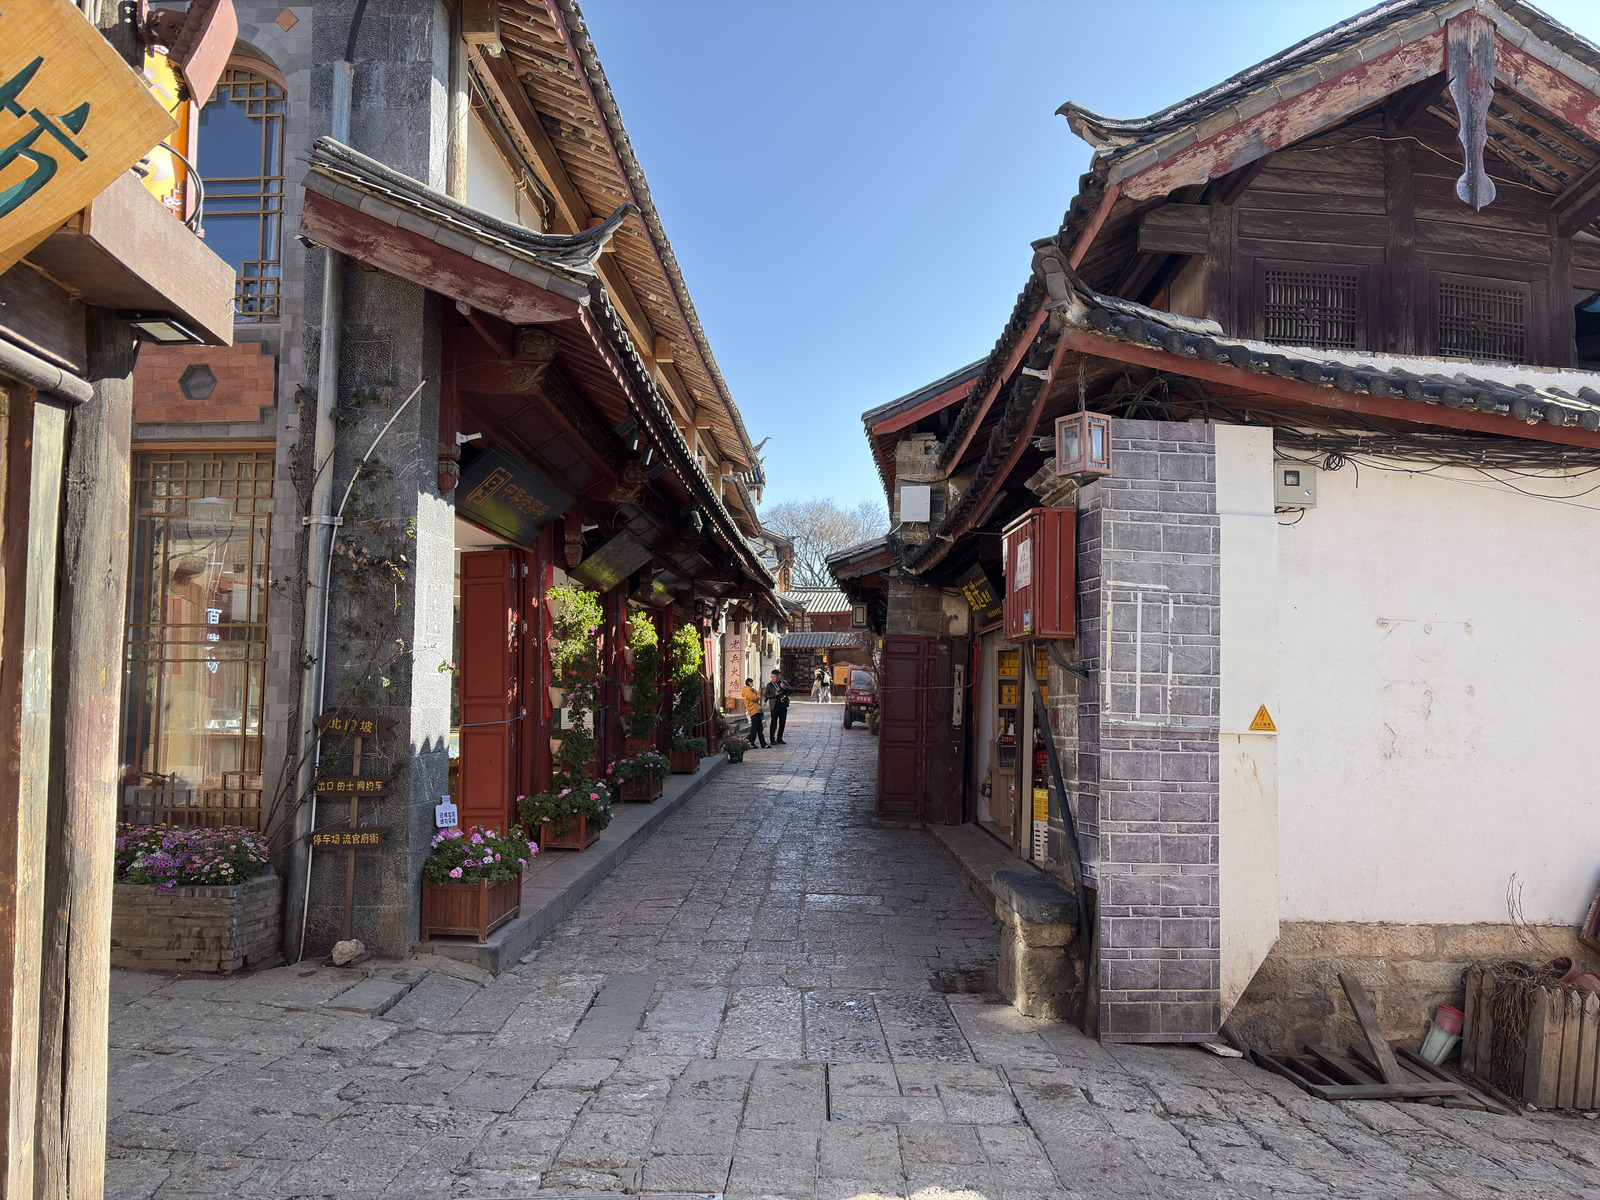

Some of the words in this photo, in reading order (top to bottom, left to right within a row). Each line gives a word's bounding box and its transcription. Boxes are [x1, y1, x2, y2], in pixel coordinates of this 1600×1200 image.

[729, 639, 740, 690] 老兵火塘
[329, 717, 373, 733] 北门坡
[317, 781, 334, 791] 出口
[337, 781, 354, 791] 的士
[356, 781, 383, 791] 网约车
[313, 834, 340, 846] 停车场
